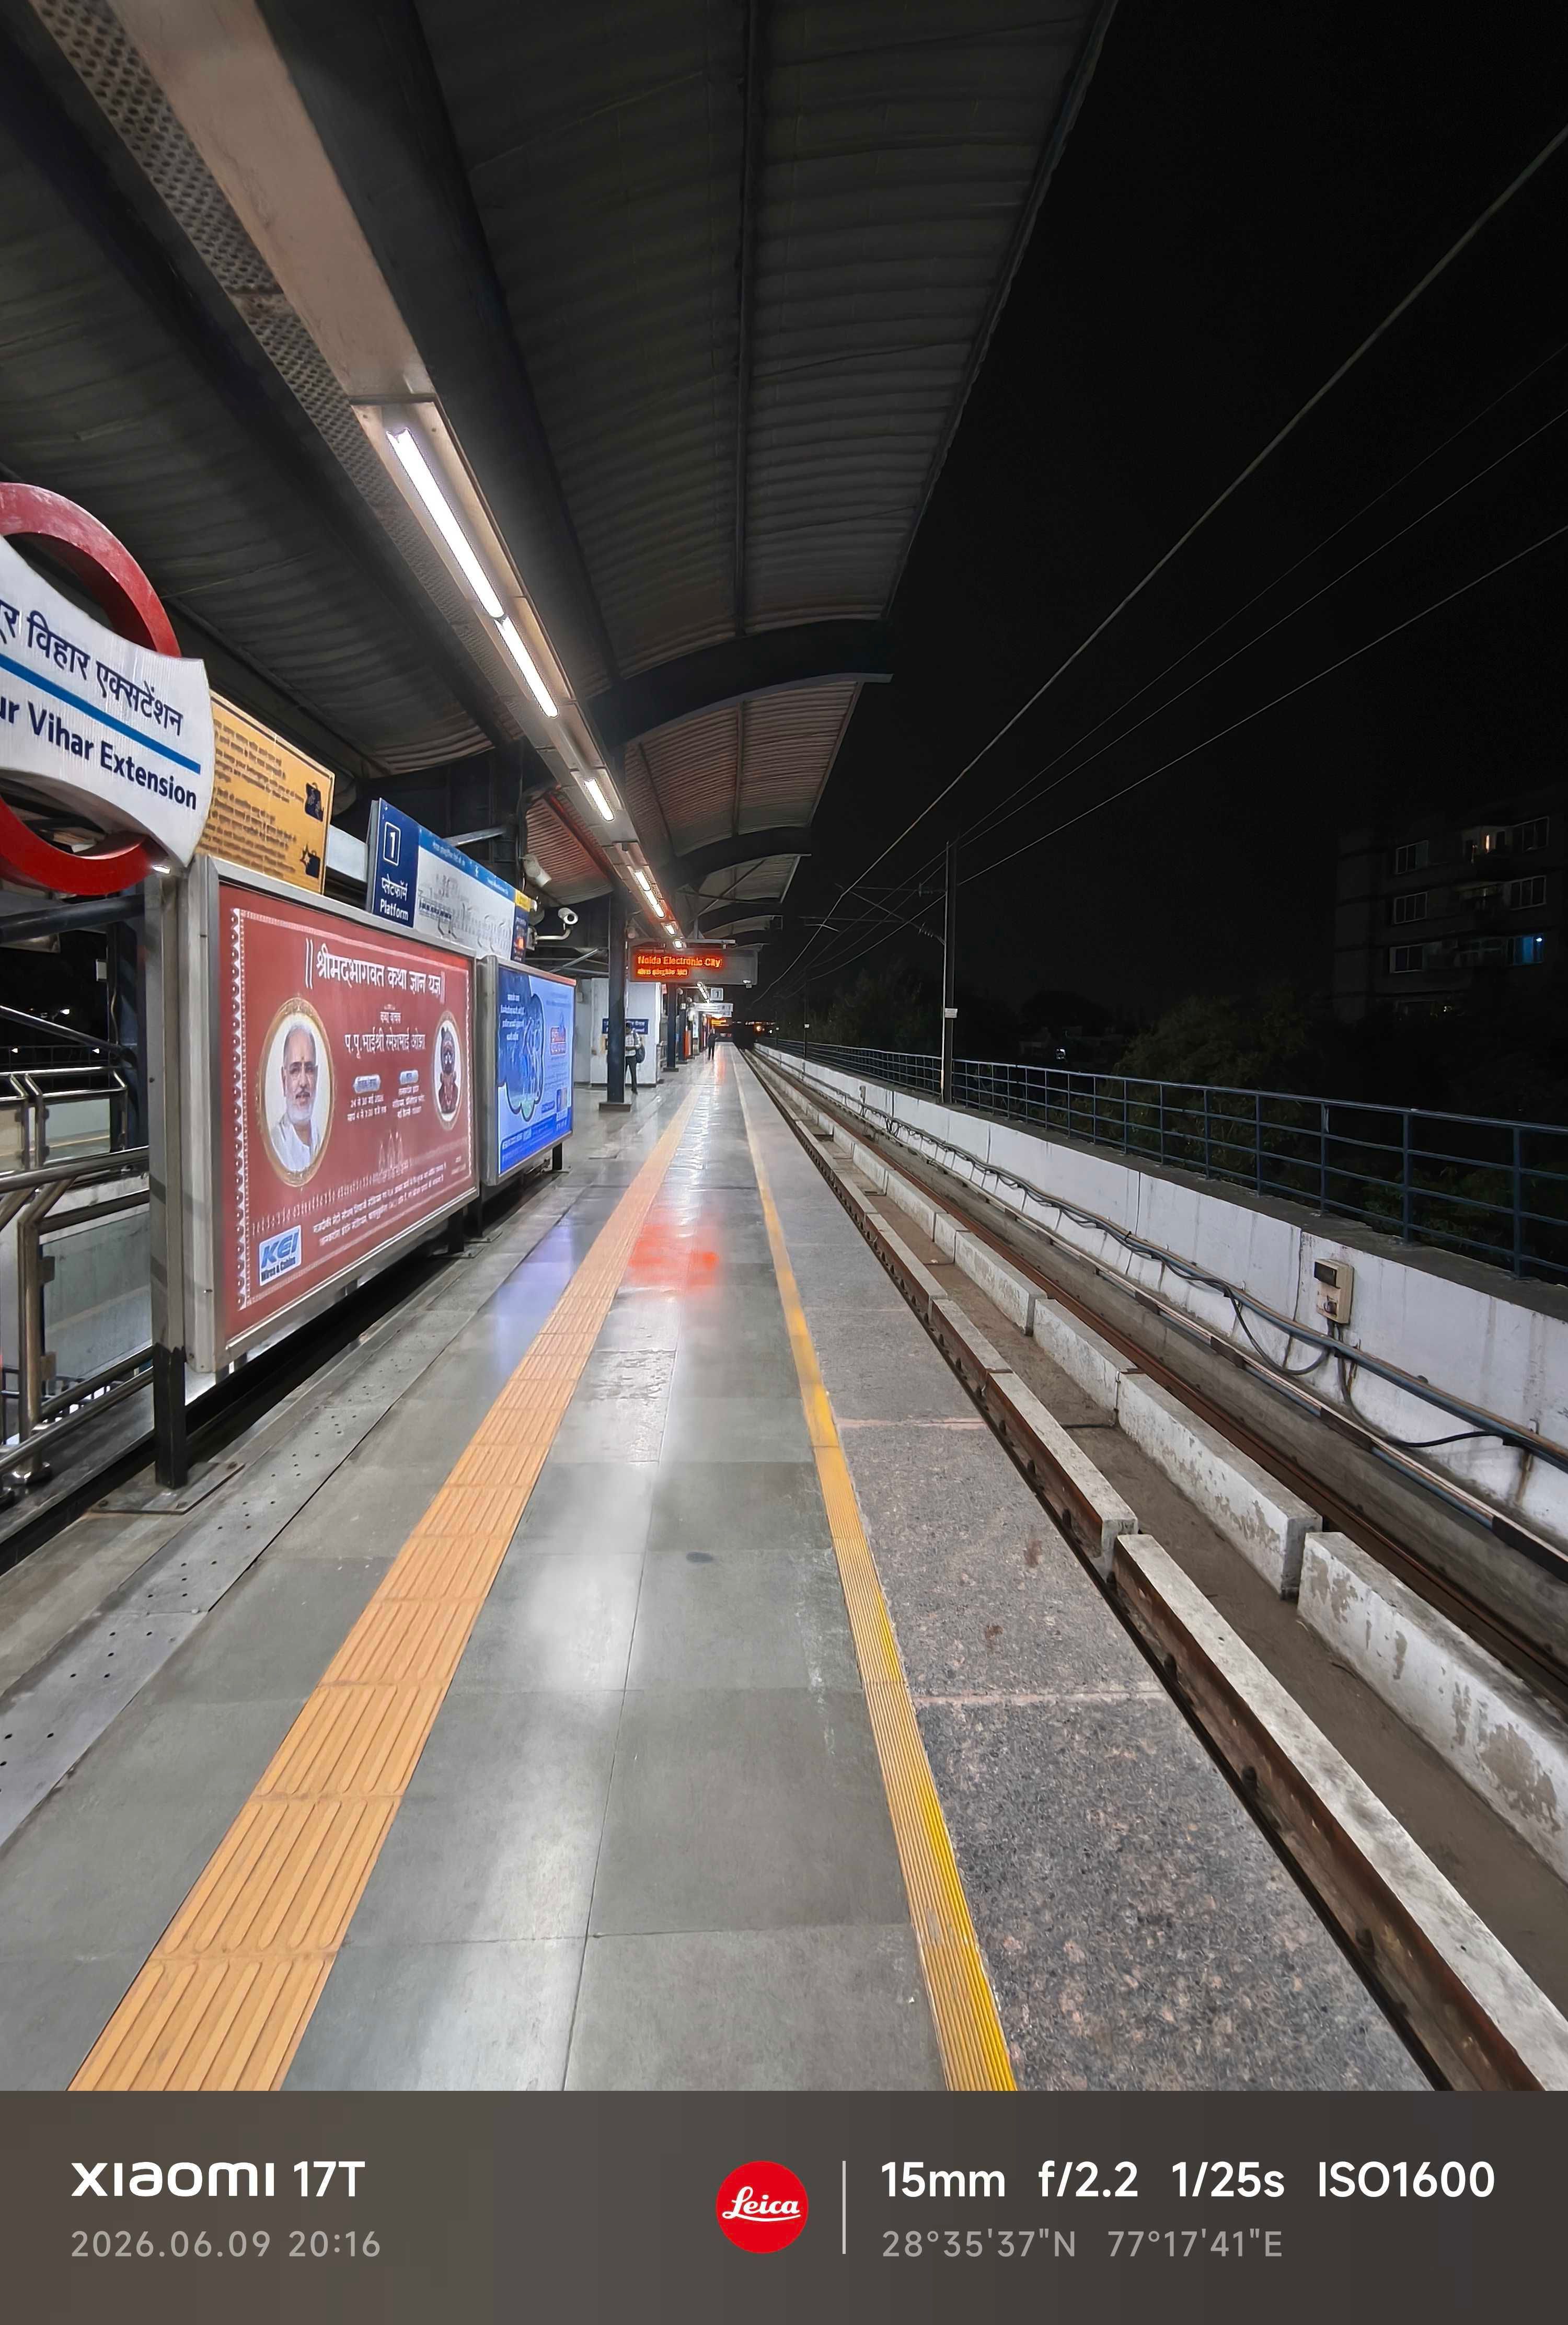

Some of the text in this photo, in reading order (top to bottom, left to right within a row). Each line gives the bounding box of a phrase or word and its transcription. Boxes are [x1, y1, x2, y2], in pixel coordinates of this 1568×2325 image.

[27, 610, 90, 680] विहार
[96, 660, 184, 736] एक्सटेंशन
[28, 699, 94, 760] Vihar
[100, 740, 197, 810] Extension
[389, 832, 396, 858] 1
[380, 899, 408, 920] Platform
[663, 956, 703, 966] Electronic
[387, 966, 407, 991] कथा
[409, 971, 426, 995] ज्ञान
[261, 1229, 299, 1269] KEI
